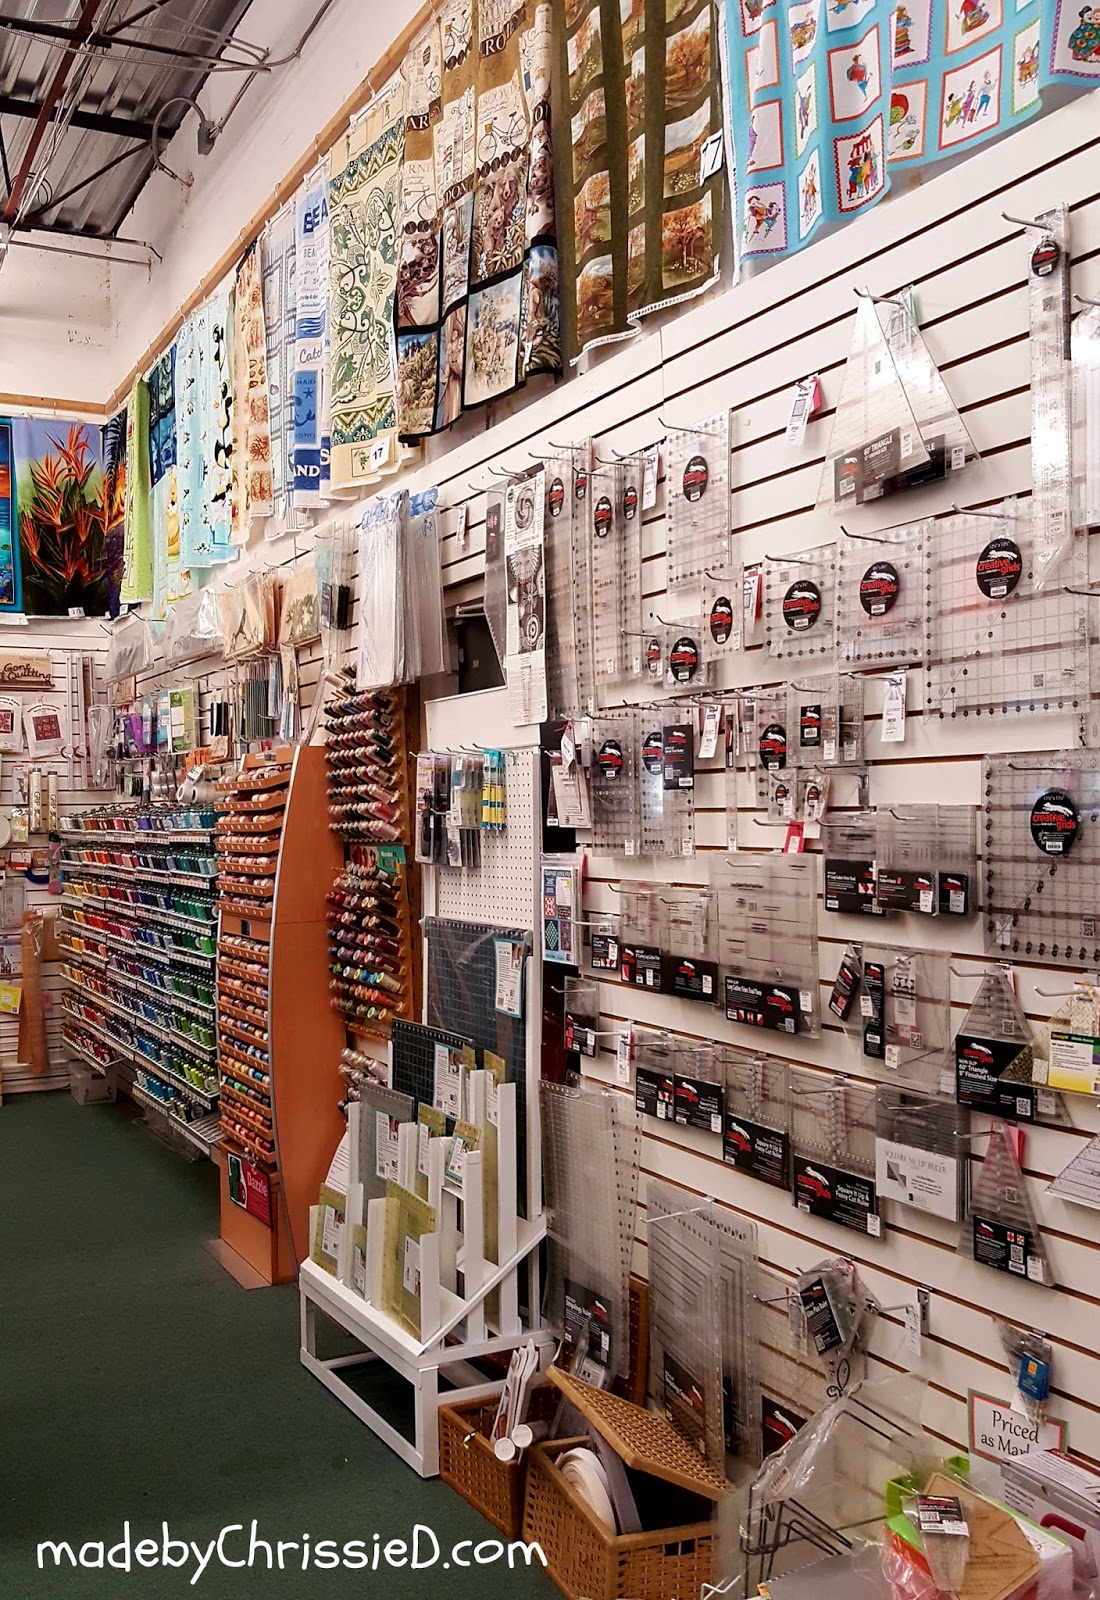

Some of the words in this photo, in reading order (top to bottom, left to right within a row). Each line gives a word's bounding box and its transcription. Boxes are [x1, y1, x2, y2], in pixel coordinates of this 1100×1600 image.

[871, 435, 893, 451] TRIANGLE
[372, 447, 384, 460] 17
[978, 558, 1009, 571] creative
[1001, 562, 1020, 575] grids
[4, 663, 30, 672] Gone
[8, 668, 51, 682] Quilting
[1032, 813, 1065, 822] creative
[1056, 819, 1076, 831] grids
[965, 1071, 986, 1080] Finished
[968, 1065, 988, 1074] Triangle
[247, 1171, 267, 1196] Dazzle
[837, 1184, 853, 1195] Square
[992, 1409, 1040, 1443] Priced
[980, 1434, 995, 1448] as
